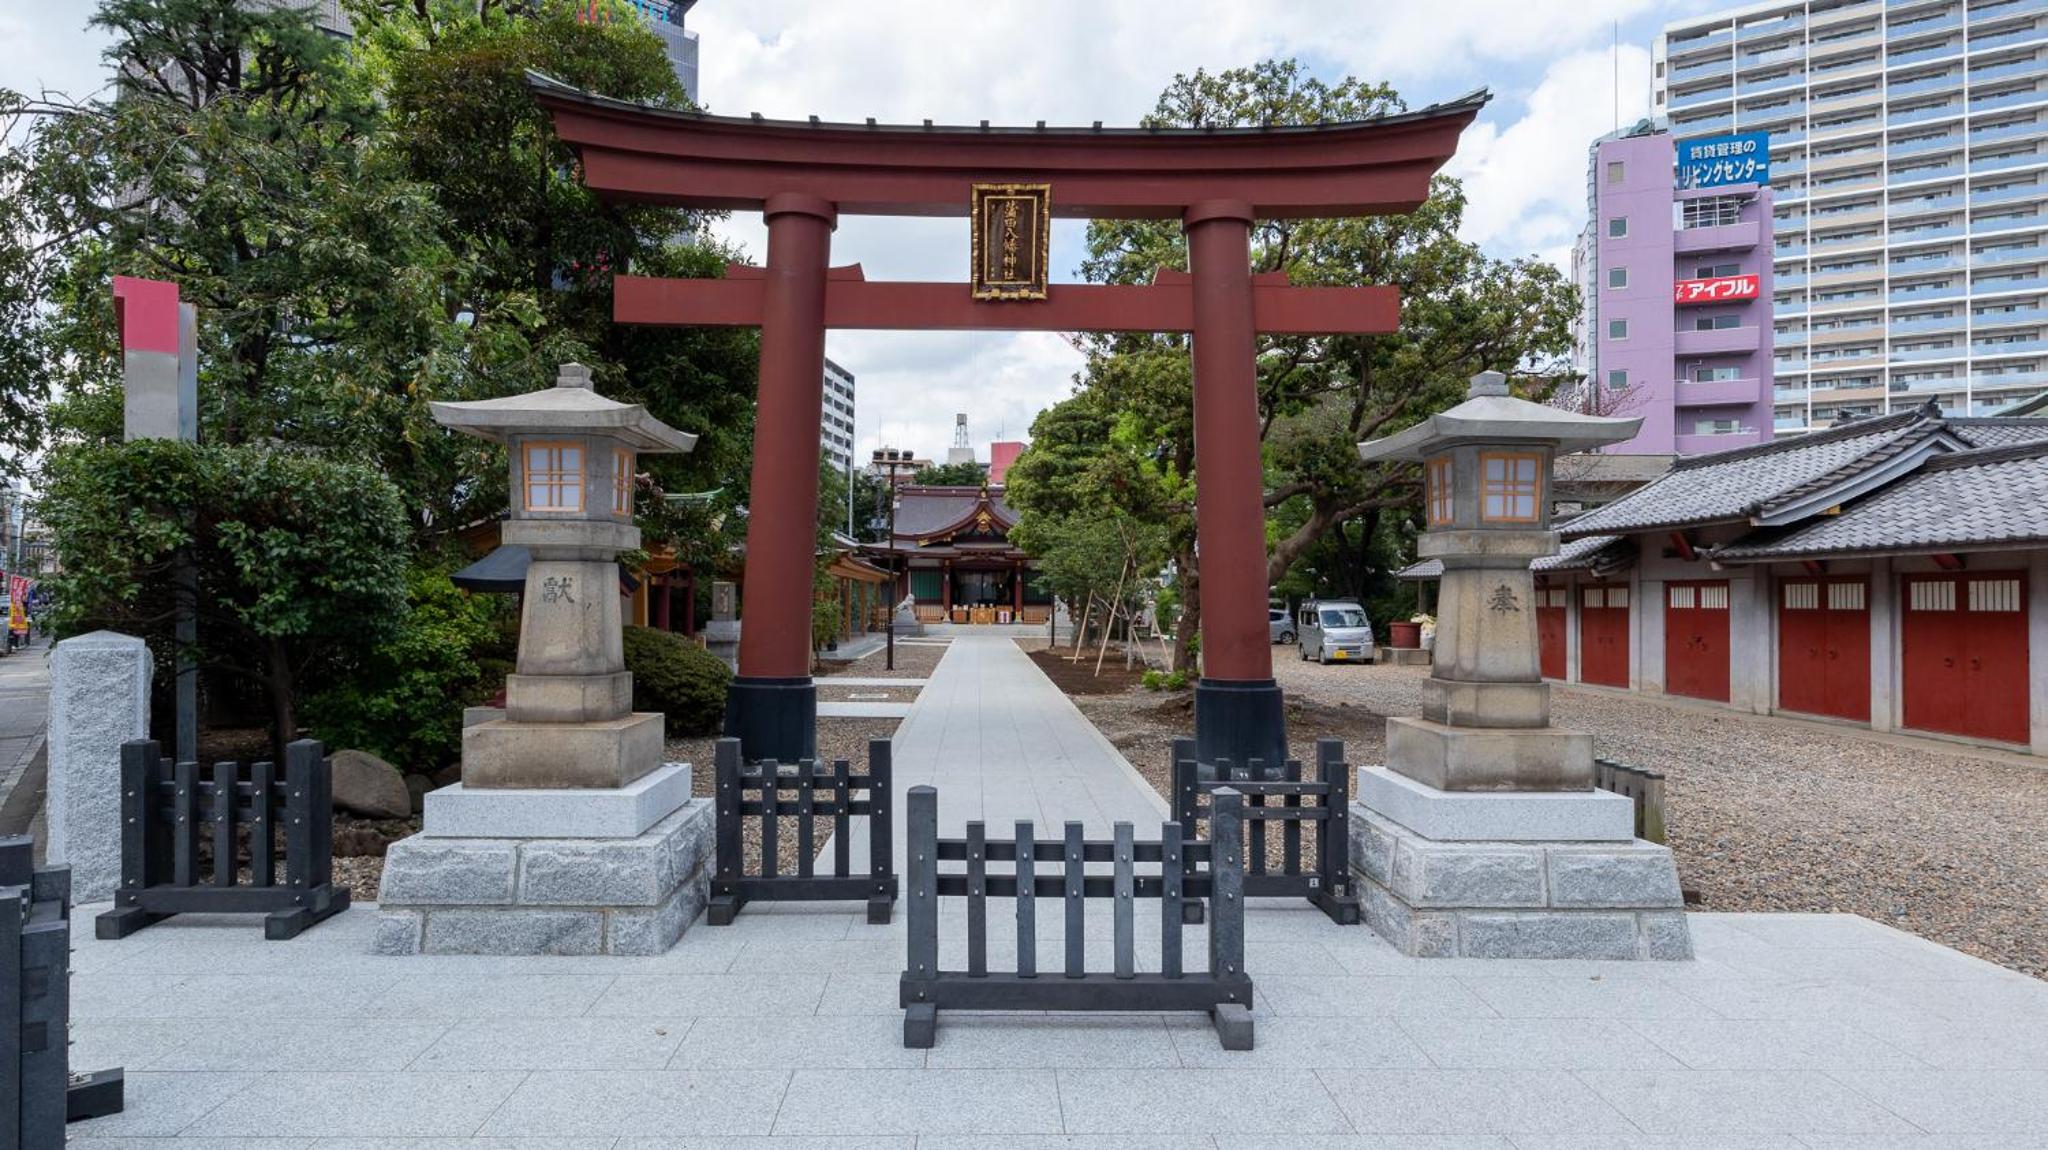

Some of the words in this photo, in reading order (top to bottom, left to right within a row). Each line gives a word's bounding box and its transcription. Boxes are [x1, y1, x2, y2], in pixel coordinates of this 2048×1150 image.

[1682, 158, 1767, 187] リビングセンター
[1687, 279, 1755, 299] アイフル
